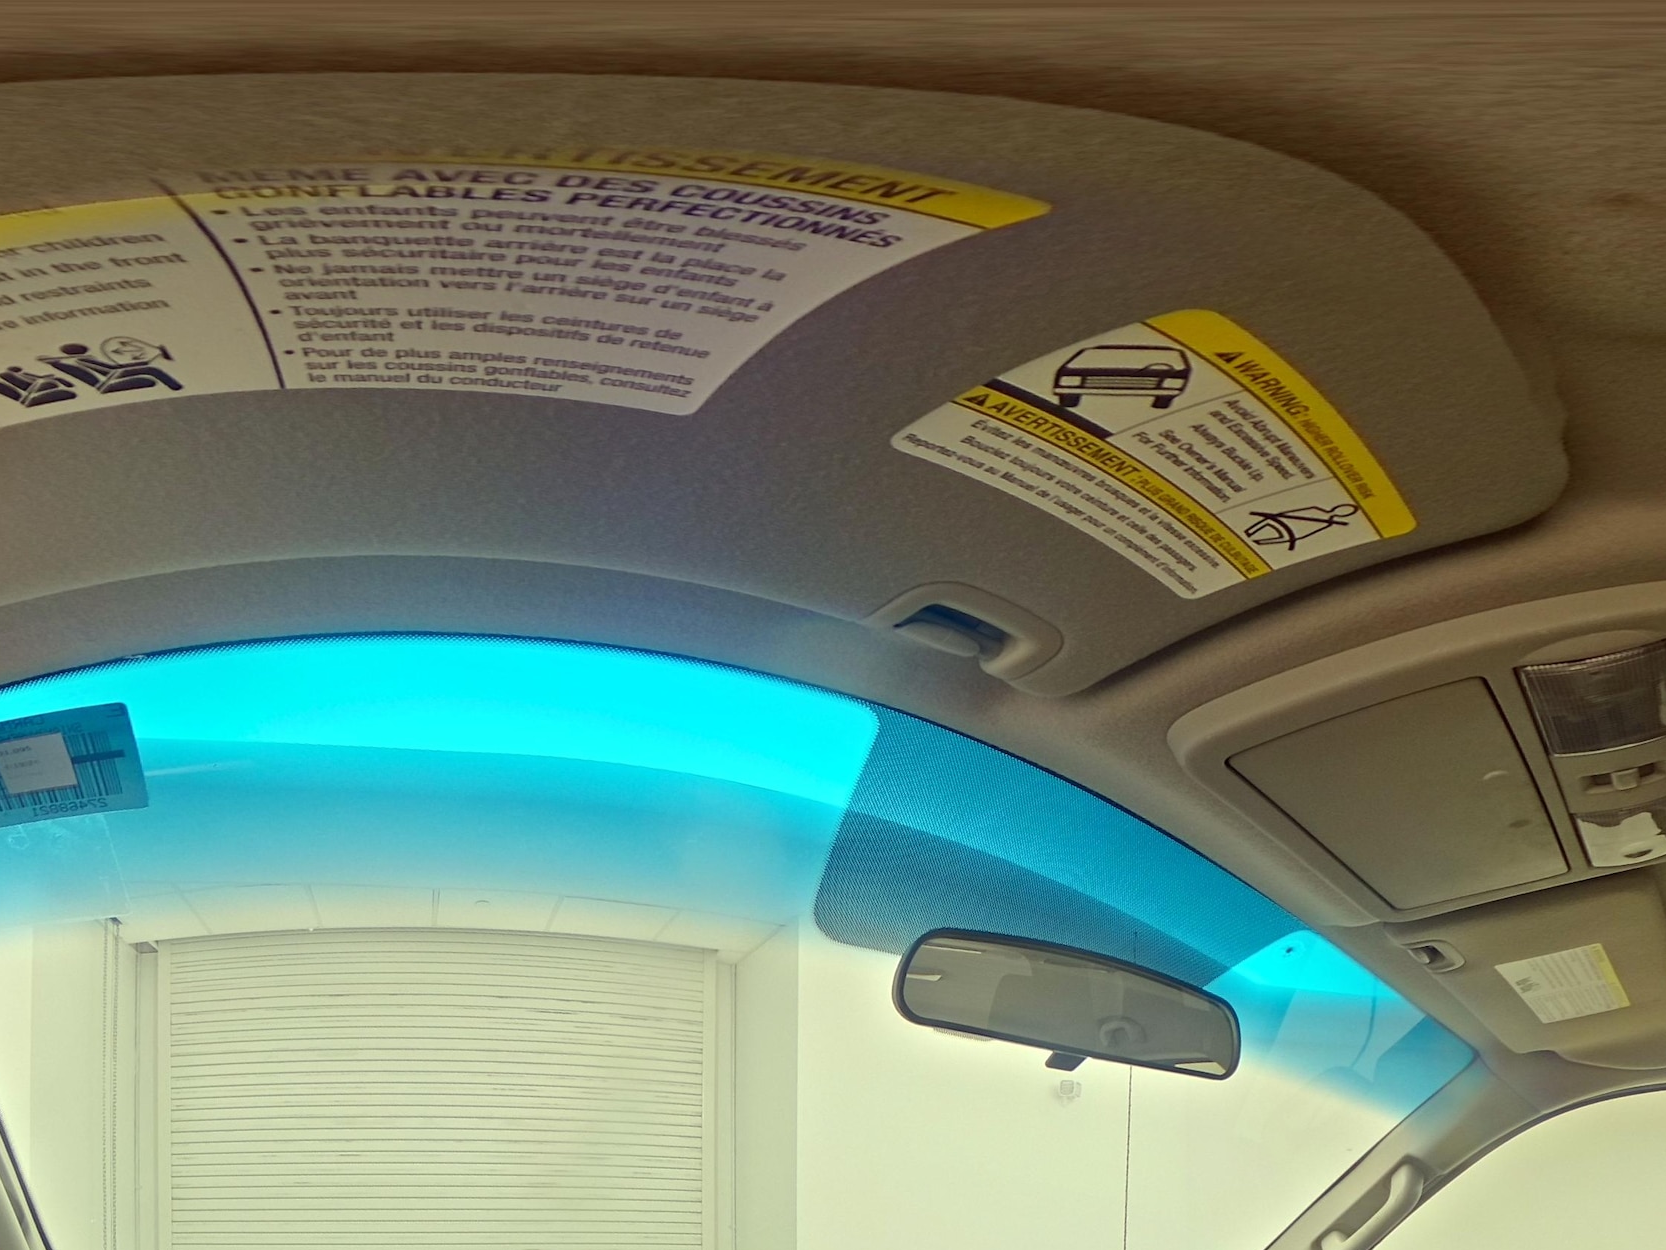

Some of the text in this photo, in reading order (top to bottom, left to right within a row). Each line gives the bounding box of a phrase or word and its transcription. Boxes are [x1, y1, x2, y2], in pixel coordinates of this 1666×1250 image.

[214, 185, 904, 248] GONFLABLES PERFECTIONNÉS
[391, 168, 539, 186] AVEC
[556, 174, 660, 194] DES
[670, 184, 890, 225] COUSSINS
[28, 232, 167, 253] children
[239, 205, 808, 252] Les enfants peuvent être blessés
[460, 221, 504, 233] ou
[513, 223, 727, 254] mortellement
[20, 265, 49, 279] in
[50, 258, 103, 273] the
[107, 251, 187, 270] front
[255, 233, 788, 283] La banquette arrière est la place la
[266, 246, 739, 288] plus sécuritaire pour les enfants
[21, 277, 153, 303] restraints
[273, 262, 775, 313] Ne jamais mettre un siège d'enfant à
[278, 275, 760, 324] orientation vers l'arrière sur un siège
[284, 288, 359, 301] avant
[21, 298, 171, 326] information
[290, 305, 684, 341] Toujours utiliser les ceintures de
[293, 316, 711, 359] sécurité et les dispositifs de retenue
[296, 330, 396, 343] d'enfant
[301, 346, 696, 387] Pour de plus amples renseignements
[304, 358, 693, 399] sur les coussins gonflables, consultez
[307, 372, 563, 393] le manuel du conducteur
[1209, 409, 1270, 459] and Excessive
[1223, 398, 1257, 423] Avoid
[1251, 417, 1283, 445] Abrupt
[959, 434, 1013, 461] Bouclez
[1012, 435, 1034, 450] les
[1132, 430, 1156, 447] For
[1151, 440, 1189, 469] Further
[1157, 428, 1247, 494] See Owner's Manual
[1188, 422, 1255, 474] Always Buckle
[1325, 445, 1366, 487] ROLLOVER
